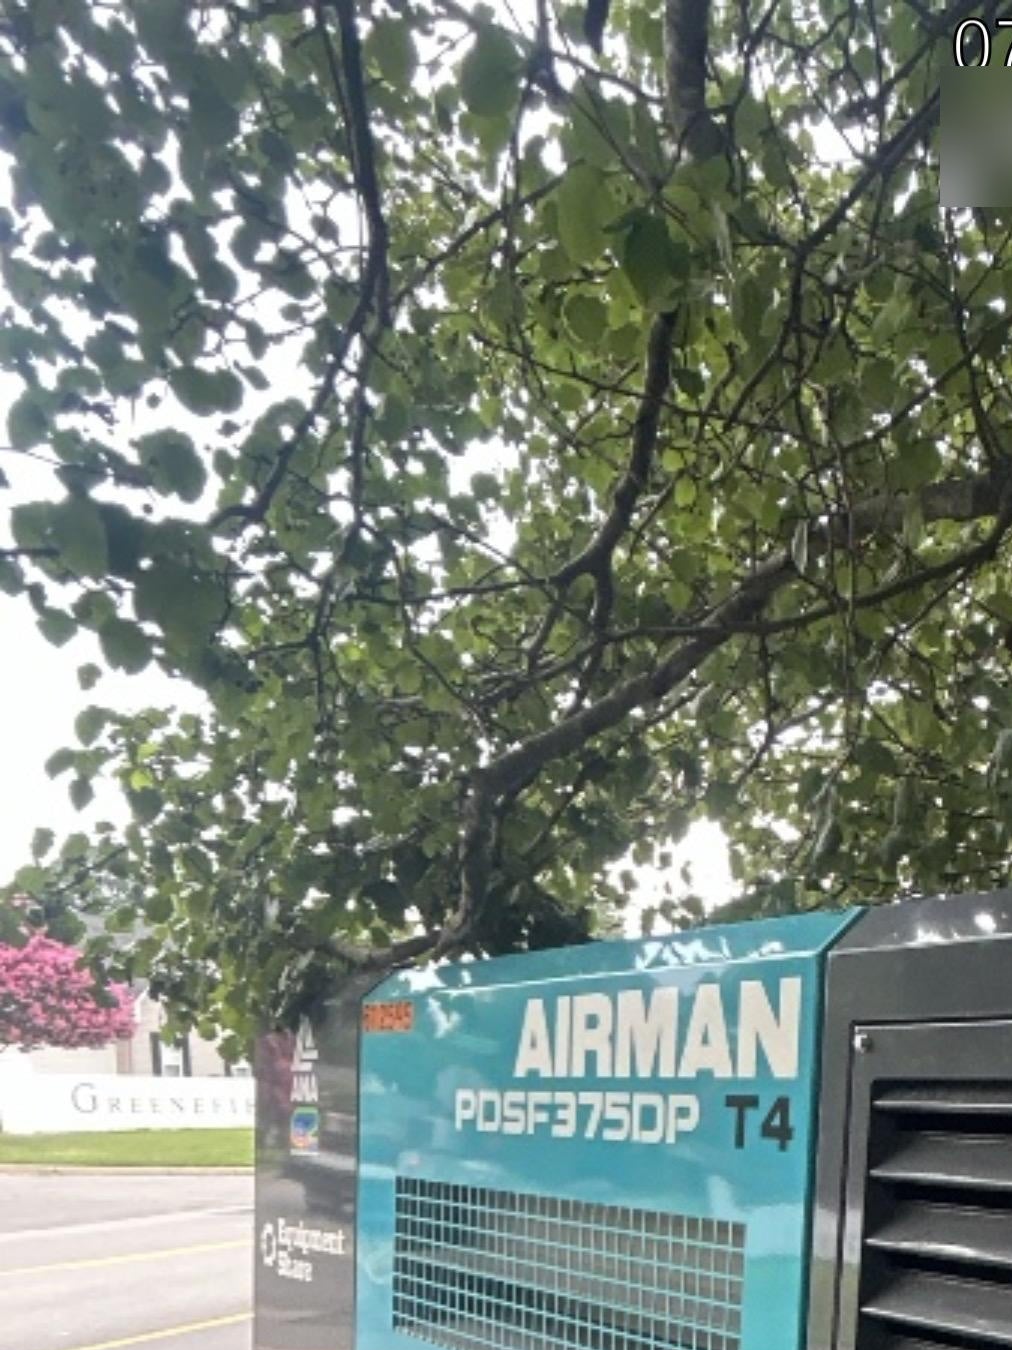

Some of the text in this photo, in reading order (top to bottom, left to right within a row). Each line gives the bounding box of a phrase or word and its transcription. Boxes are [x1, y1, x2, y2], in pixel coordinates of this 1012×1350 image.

[513, 976, 801, 1080] AIRMAN
[455, 1088, 795, 1152] PDSF375DP T4
[278, 1217, 345, 1255] Equipment
[278, 1251, 312, 1282] Share
